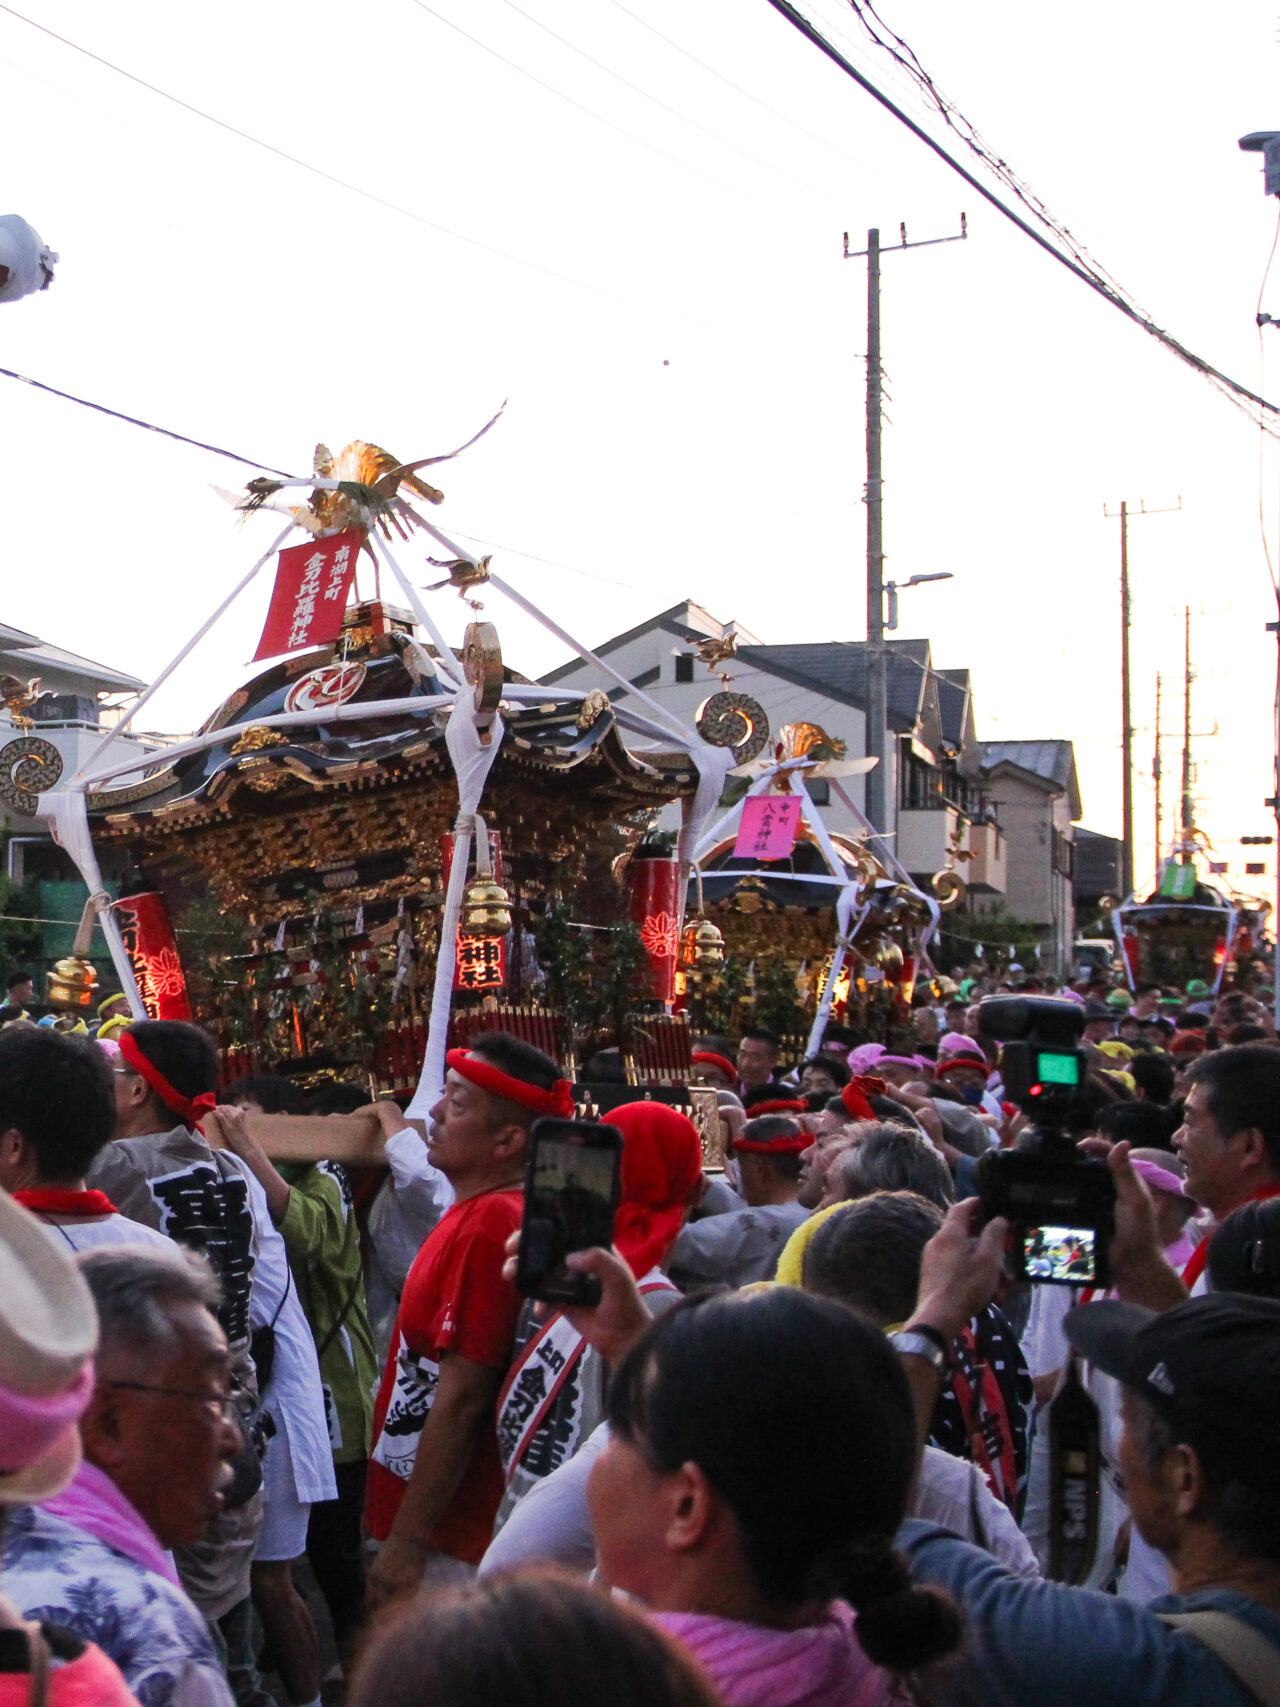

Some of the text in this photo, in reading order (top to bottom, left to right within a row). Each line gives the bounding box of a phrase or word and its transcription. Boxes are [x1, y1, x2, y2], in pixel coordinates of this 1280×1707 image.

[288, 552, 327, 648] 金刀比羅神社
[324, 545, 351, 600] 南湖上町
